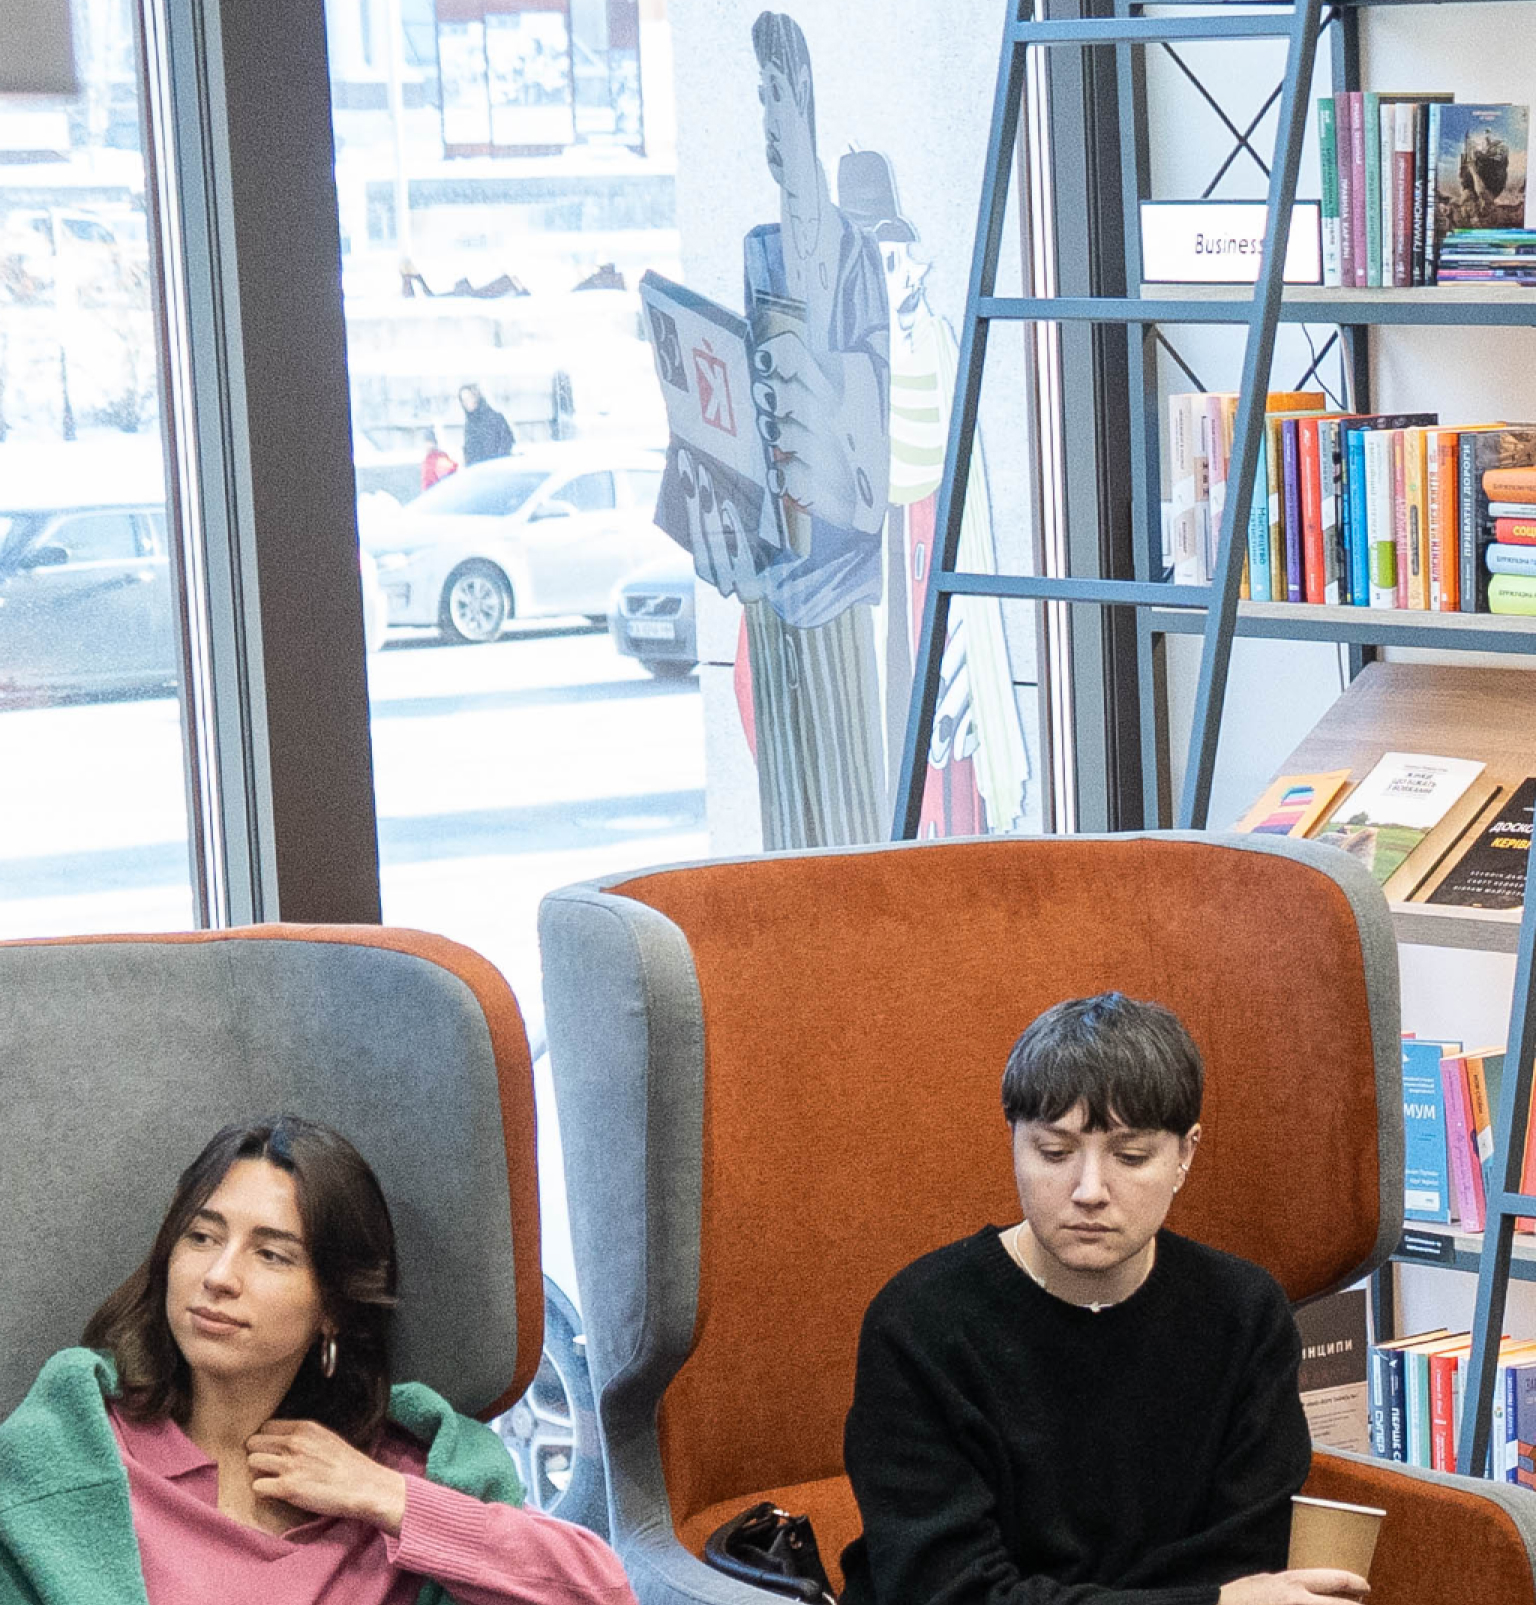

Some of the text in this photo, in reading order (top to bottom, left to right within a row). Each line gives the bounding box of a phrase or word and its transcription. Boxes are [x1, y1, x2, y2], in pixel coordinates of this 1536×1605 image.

[1195, 233, 1264, 255] Business
[1462, 444, 1472, 557] ПРИВАТНІ ДОРОГИ
[1375, 1410, 1385, 1455] СУПЕР
[1392, 1407, 1402, 1448] ПЕРШЕ
